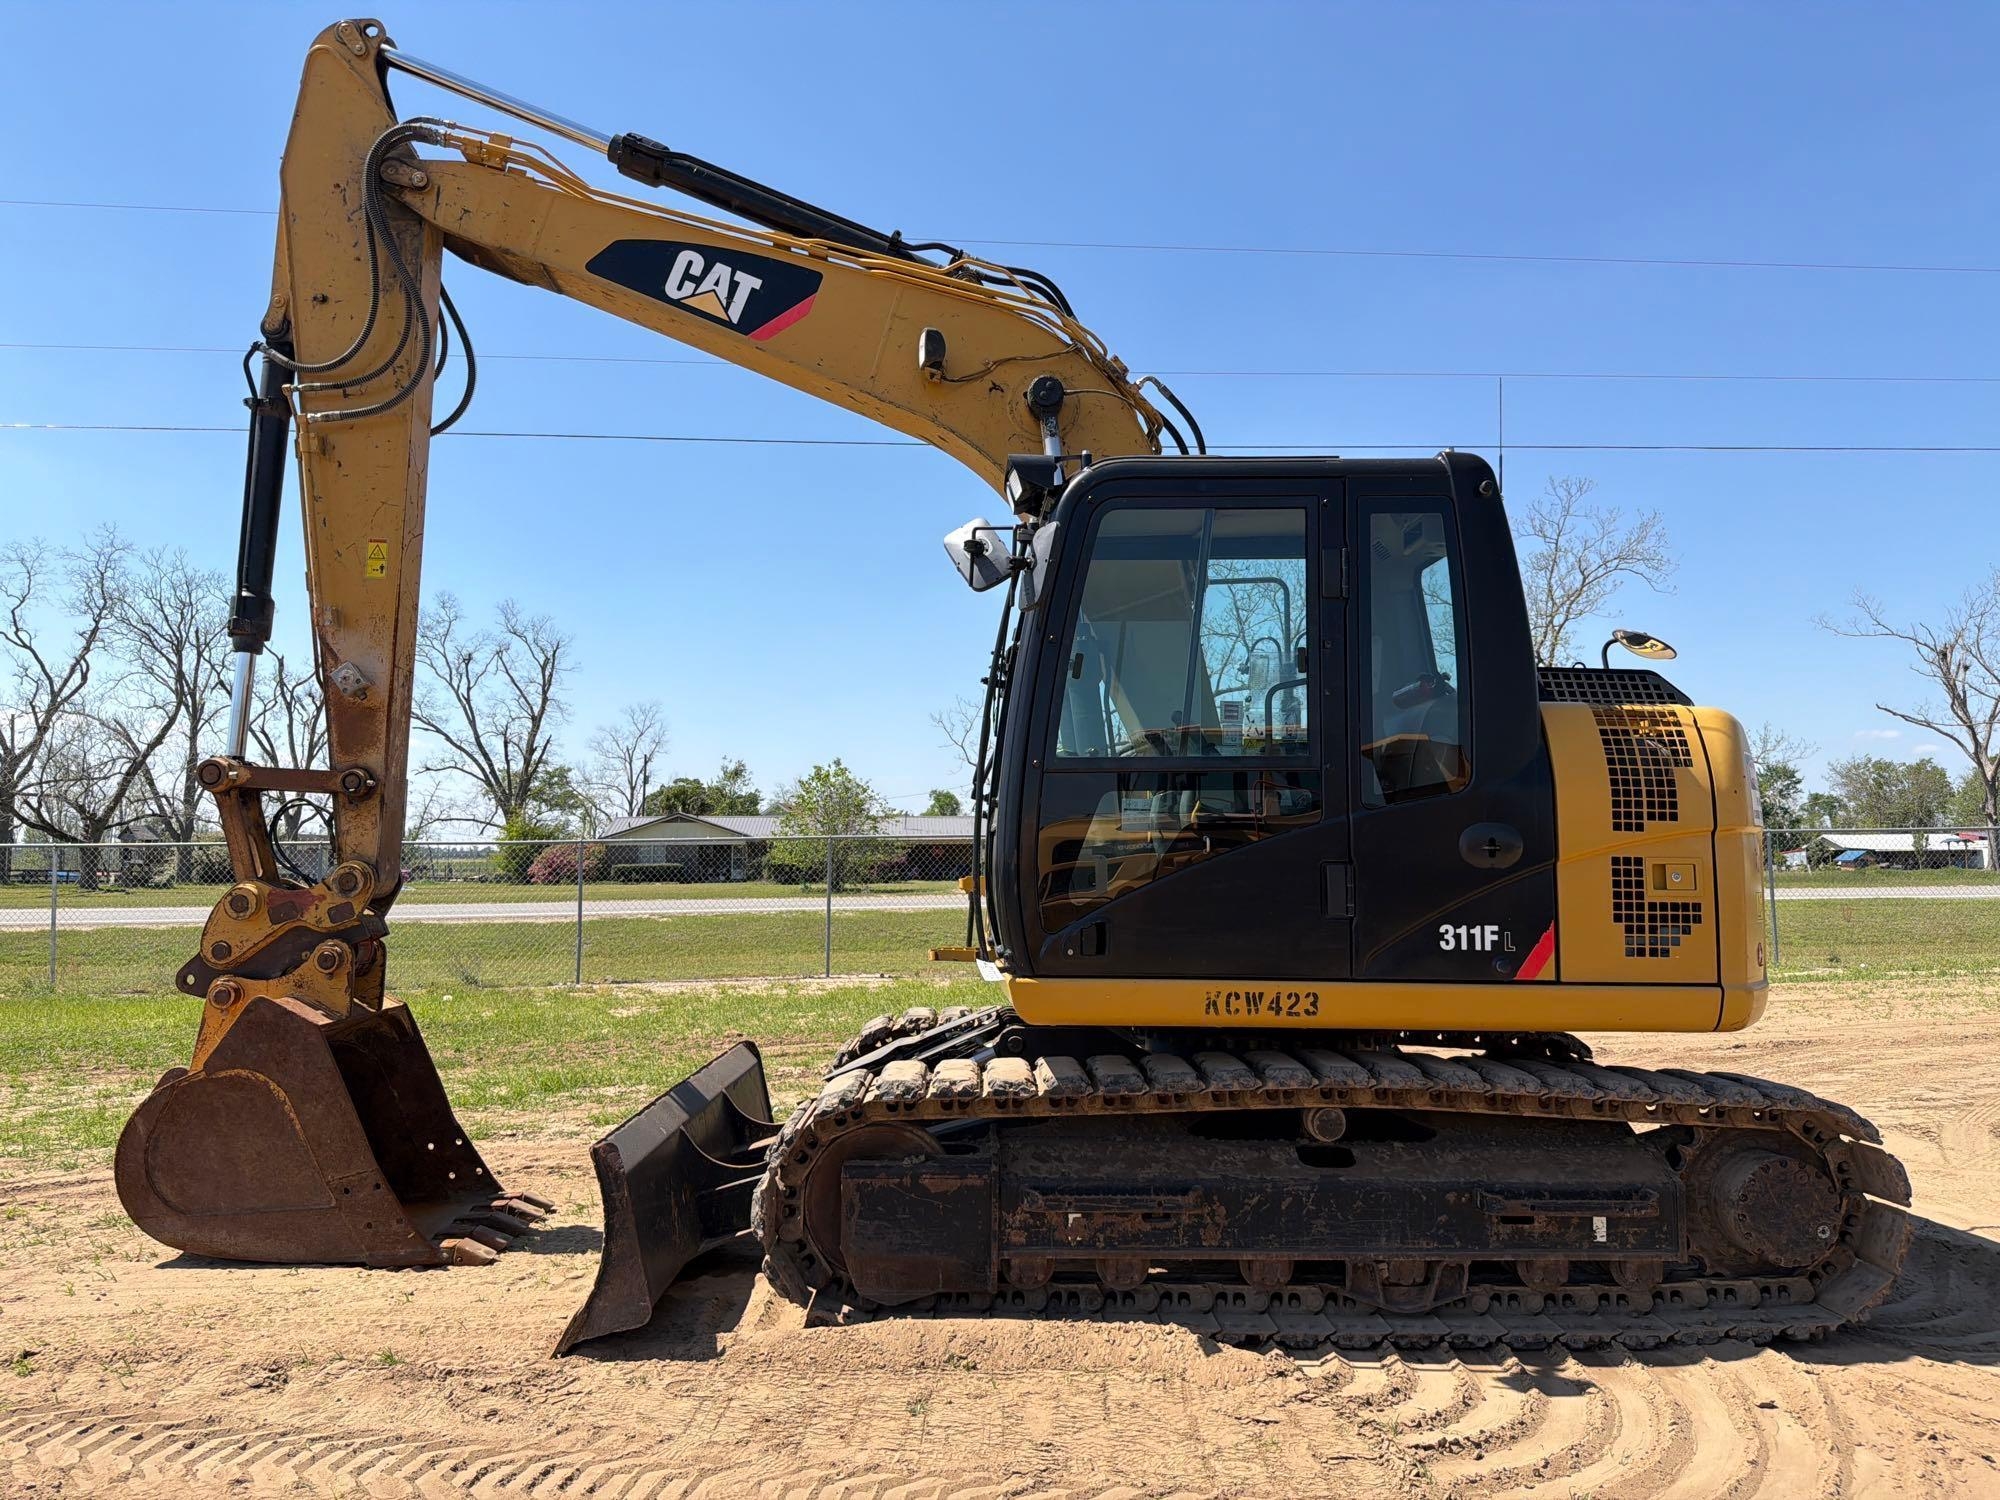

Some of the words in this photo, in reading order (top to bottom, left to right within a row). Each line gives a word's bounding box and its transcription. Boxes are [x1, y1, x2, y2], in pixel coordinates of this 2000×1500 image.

[665, 249, 762, 324] CAT
[1439, 924, 1499, 951] 311F
[1504, 931, 1516, 951] L
[1205, 991, 1319, 1016] KCW423
